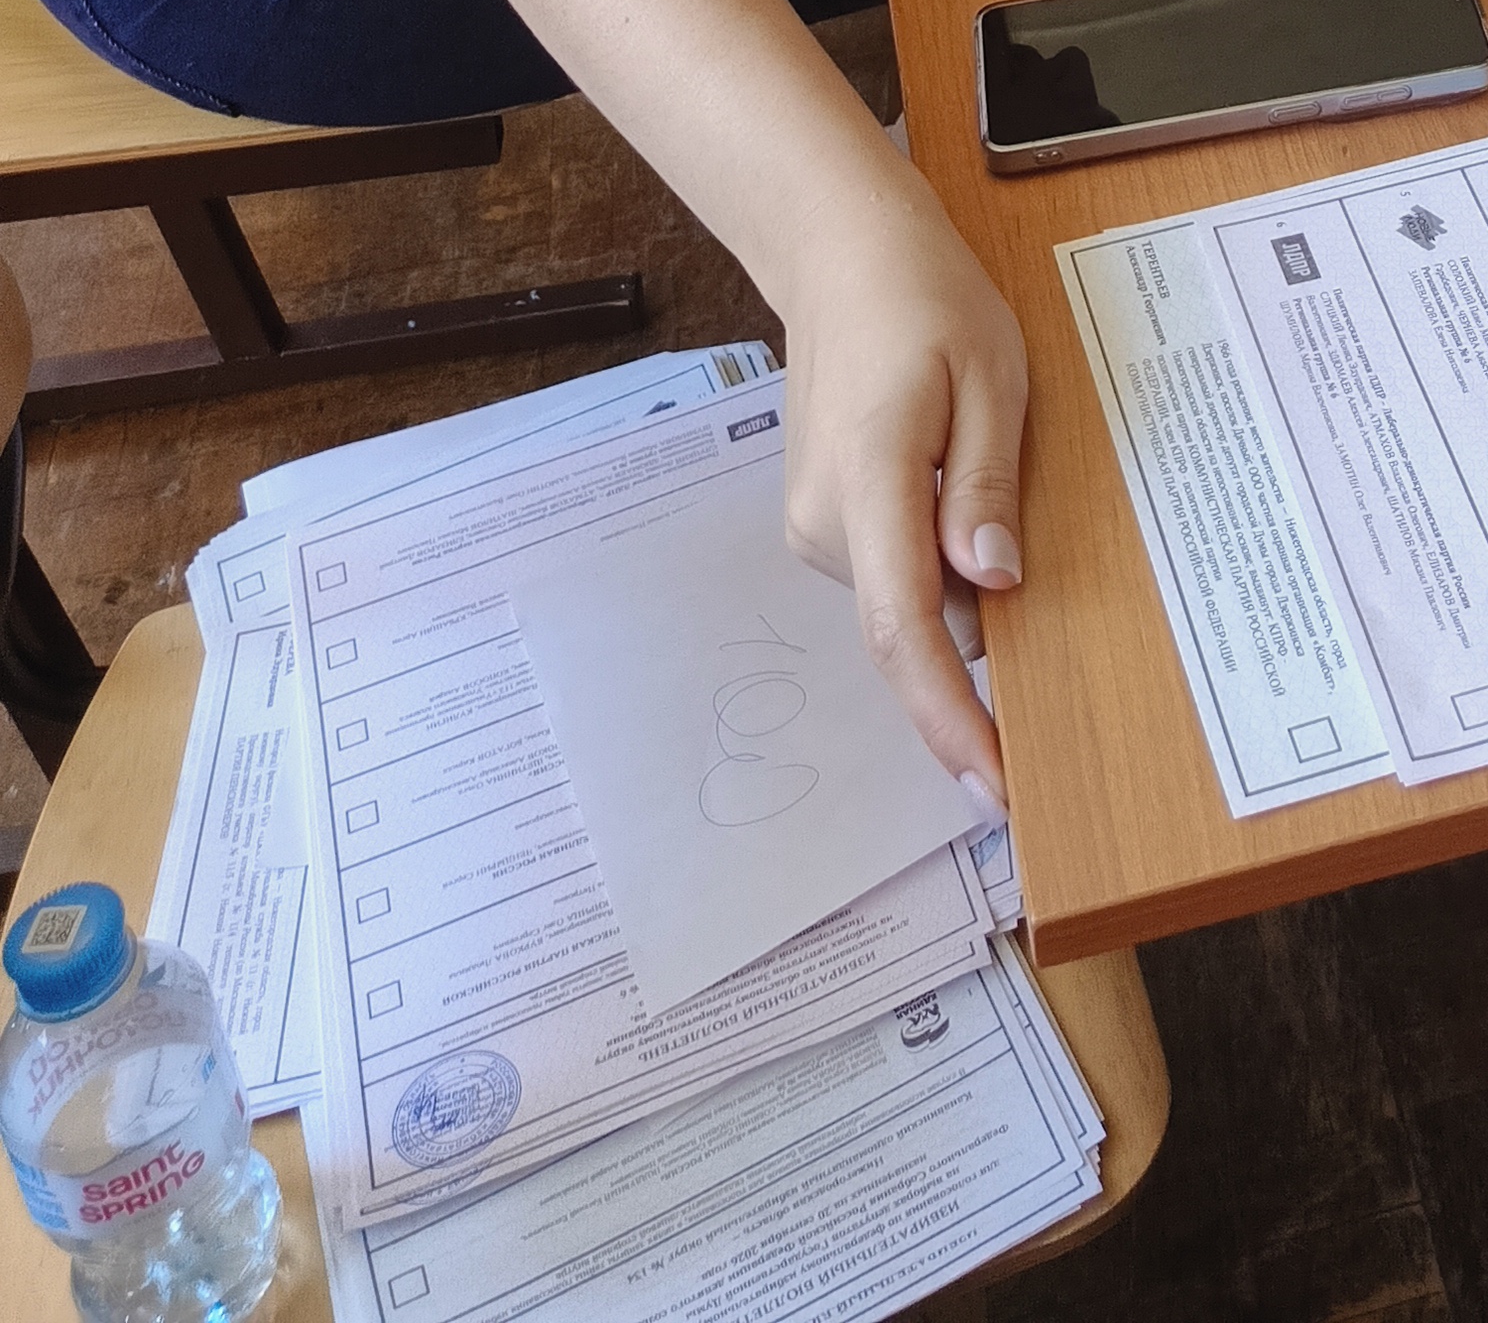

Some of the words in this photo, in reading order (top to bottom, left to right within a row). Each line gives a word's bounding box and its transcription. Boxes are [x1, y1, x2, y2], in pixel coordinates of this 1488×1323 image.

[1125, 245, 1147, 292] Александр
[1142, 293, 1166, 346] Георгиевич
[1142, 240, 1170, 299] ТЕРЕНТЬЕВ
[1281, 242, 1312, 278] ЛДПР
[732, 415, 772, 439] ЛДПР
[1126, 362, 1171, 475] КОММУНИСТИЧЕСКАЯ
[1162, 475, 1186, 519] ПАРТИЯ
[1178, 520, 1213, 597] РОССИЙСКОЙ
[1204, 599, 1237, 672] ФЕДЕРАЦИИ
[1187, 444, 1237, 563] КОММУНИСТИЧЕСКАЯ
[1229, 564, 1255, 612] ПАРТИЯ
[1246, 613, 1284, 696] РОССИЙСКОЙ
[79, 1152, 206, 1224] SPRING
[818, 1199, 959, 1284] ИЗБИРАТЕЛЬНЫЙ
